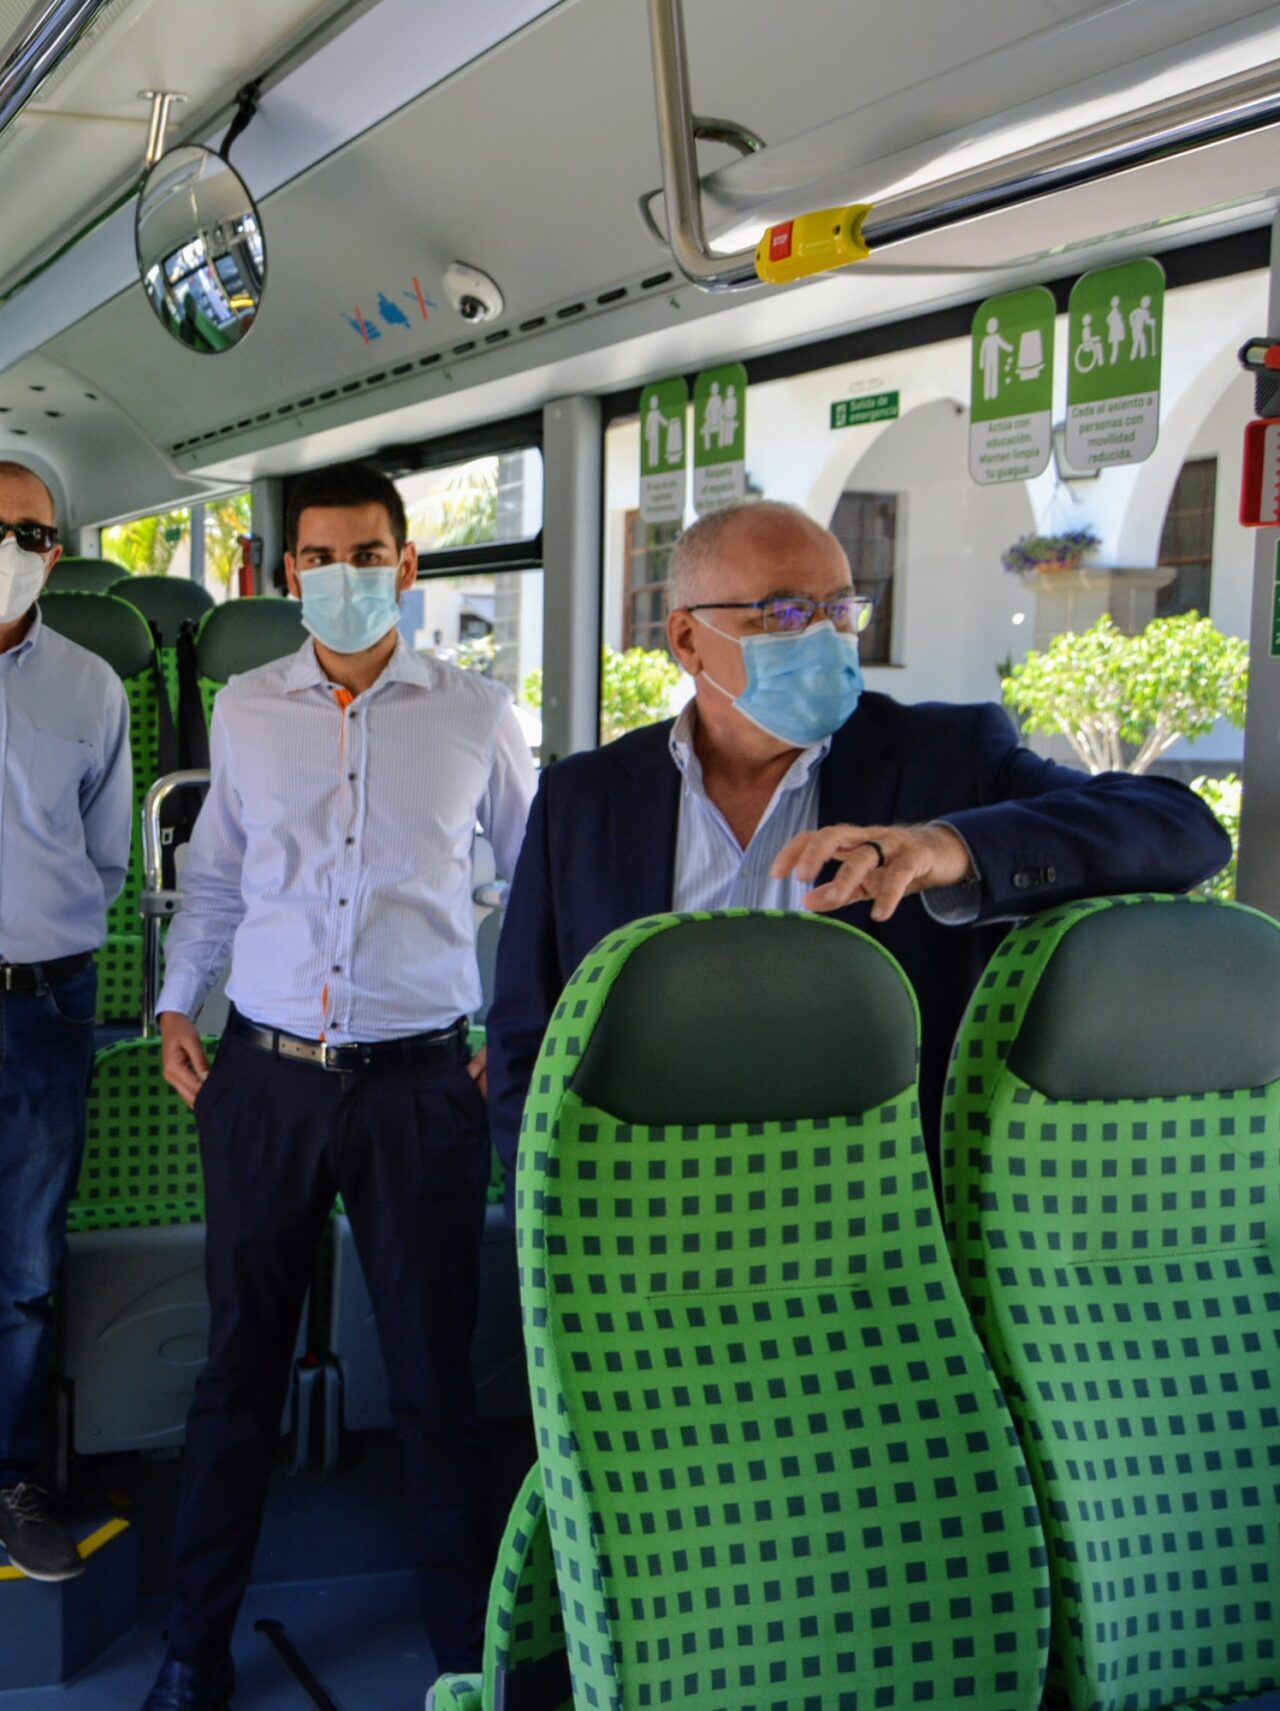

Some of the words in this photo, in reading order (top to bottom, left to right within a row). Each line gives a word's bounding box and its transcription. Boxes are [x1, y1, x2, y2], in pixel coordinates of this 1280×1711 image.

[1071, 406, 1095, 419] Cede
[1097, 404, 1106, 414] el
[1108, 398, 1144, 413] asiento
[1146, 397, 1153, 406] a
[1014, 418, 1031, 429] con
[1079, 419, 1123, 435] personas
[1125, 414, 1144, 426] con
[1087, 431, 1136, 448] movilidad
[1014, 448, 1040, 461] limpia
[1088, 448, 1132, 464] reducida.
[986, 469, 995, 479] tu
